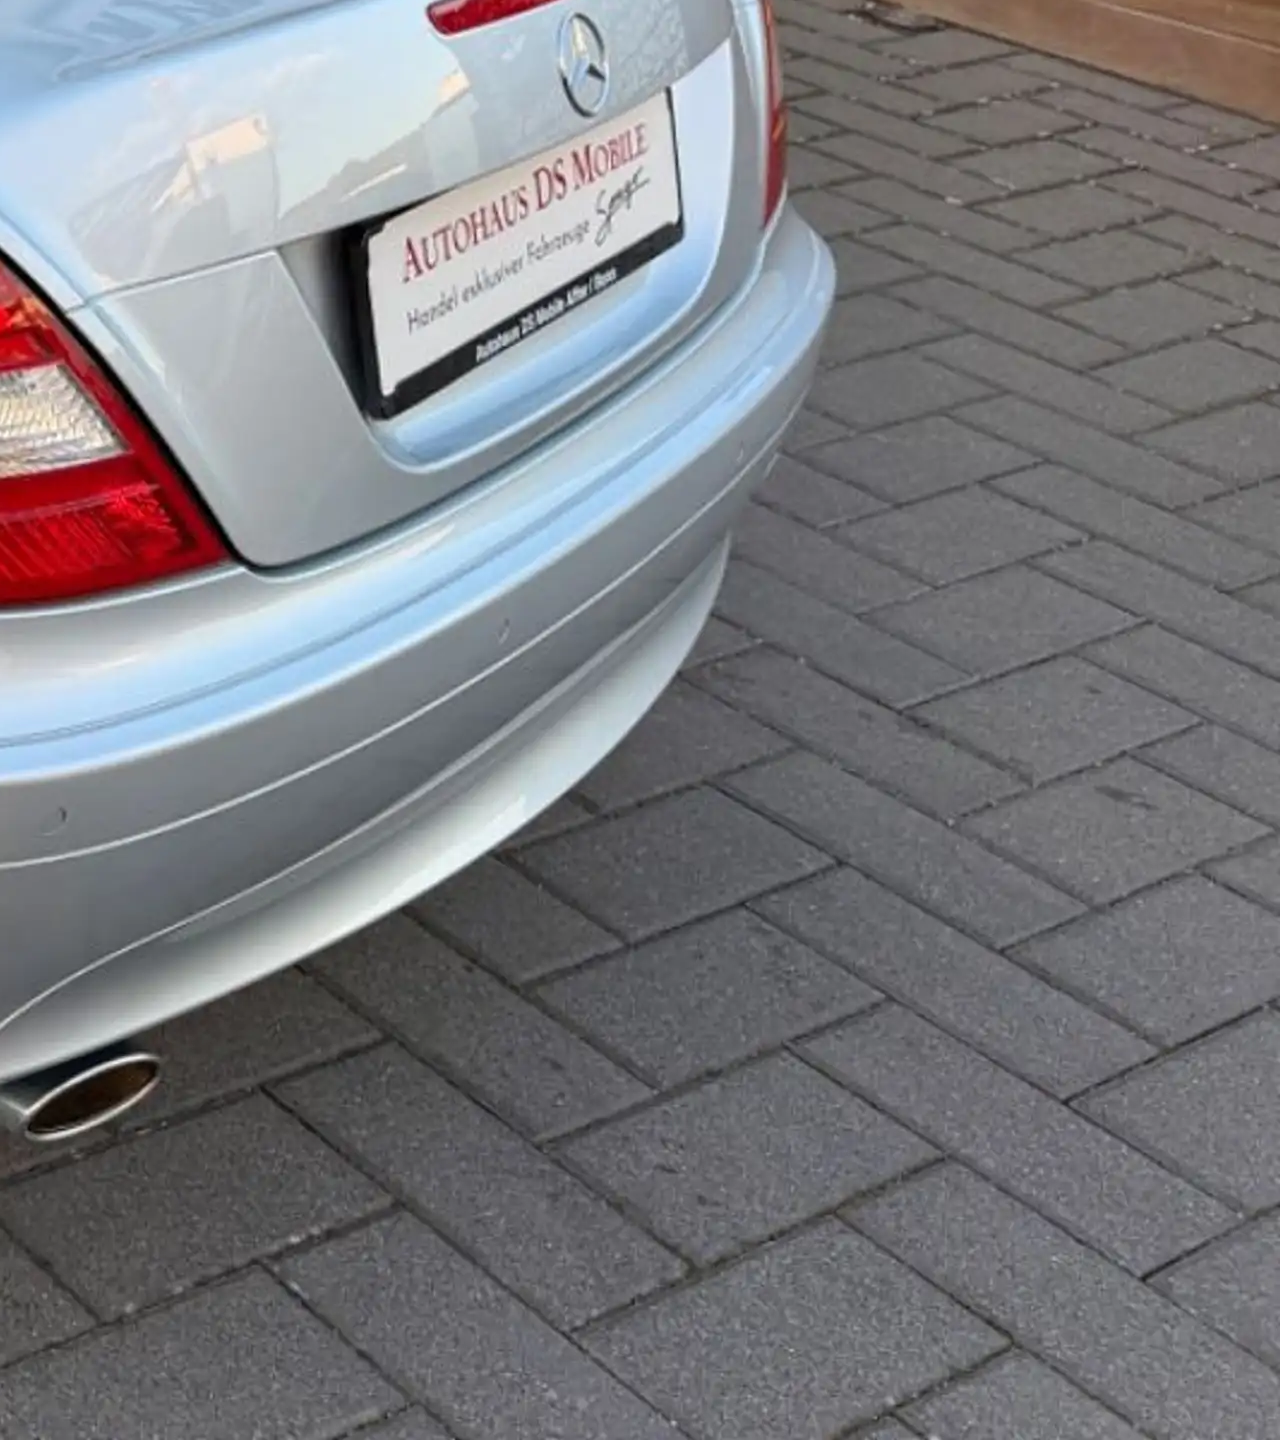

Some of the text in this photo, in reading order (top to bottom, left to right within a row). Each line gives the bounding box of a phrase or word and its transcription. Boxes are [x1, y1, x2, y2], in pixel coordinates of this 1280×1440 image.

[402, 122, 649, 284] AUTOHAUS DS MOBILE
[405, 218, 591, 336] Handel exklusiver Fahrzeuge
